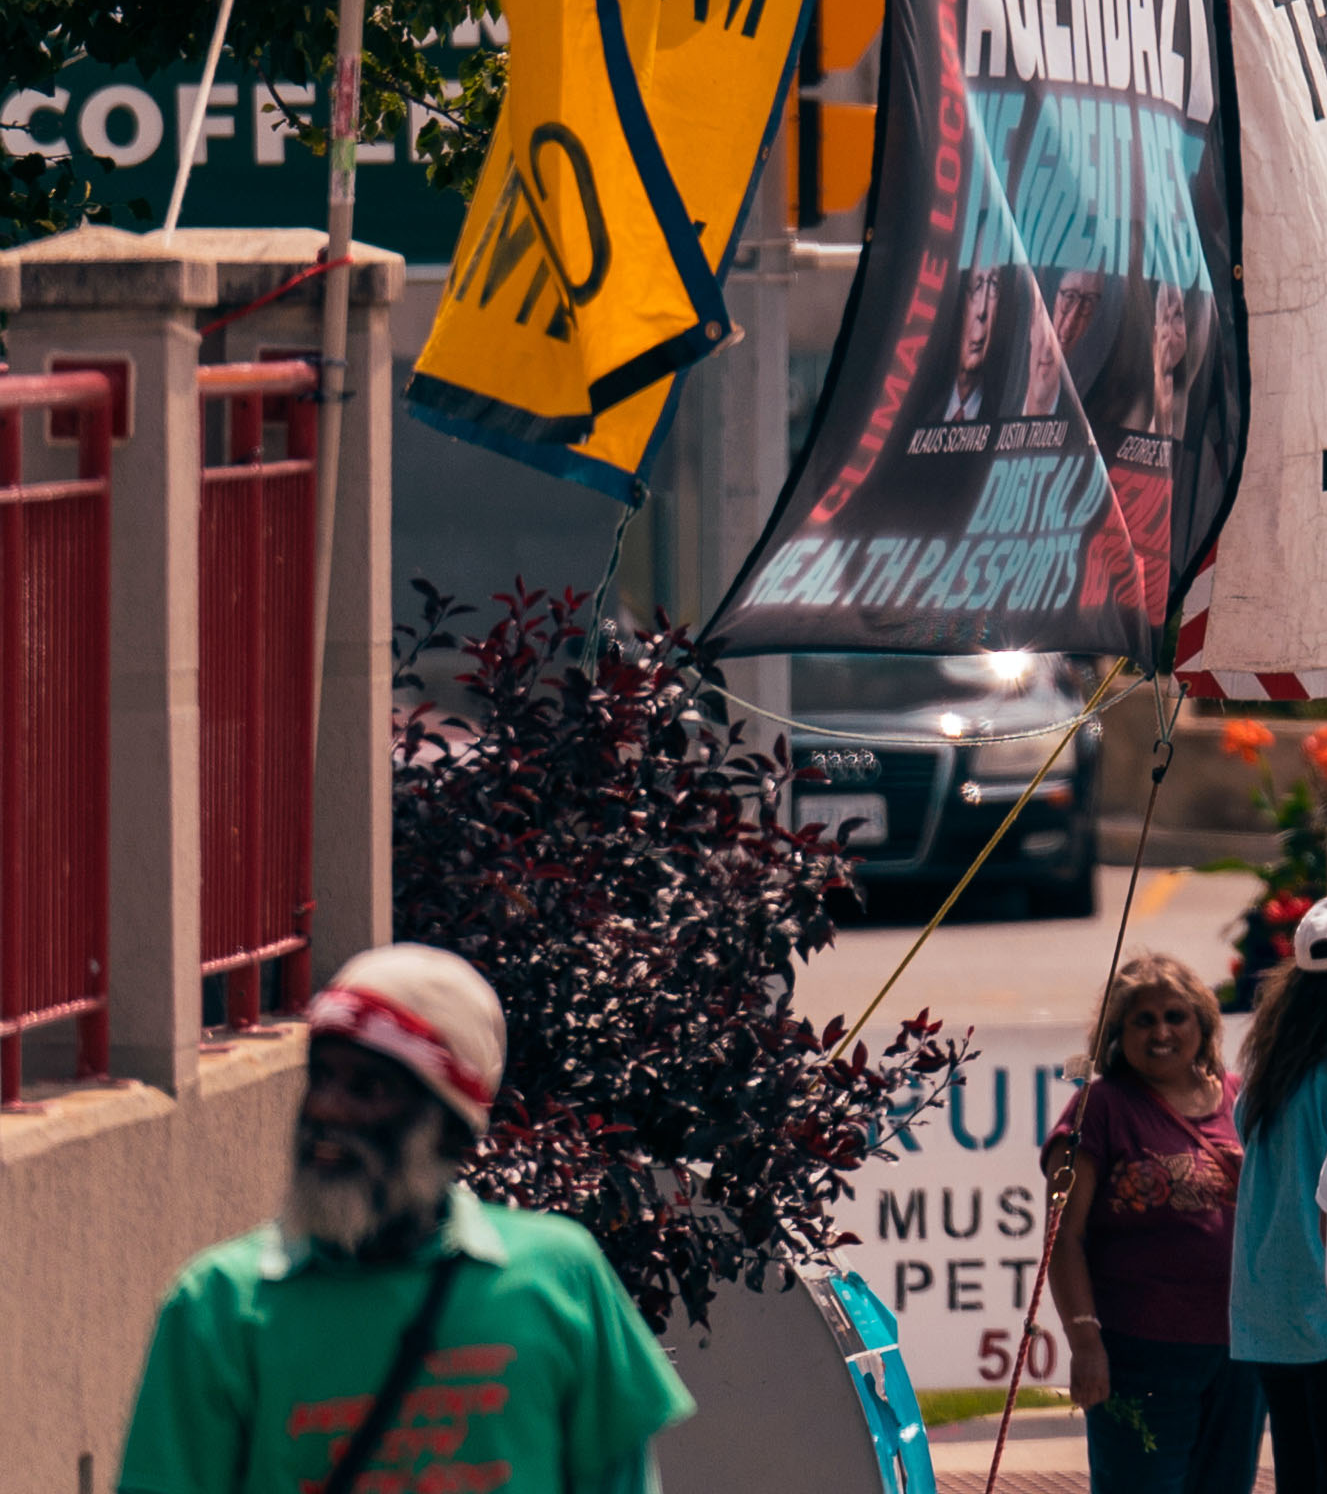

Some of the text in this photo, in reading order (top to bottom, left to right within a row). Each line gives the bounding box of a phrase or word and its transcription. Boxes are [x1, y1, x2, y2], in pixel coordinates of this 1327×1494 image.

[1014, 92, 1140, 278] GREAT
[809, 247, 954, 524] CLIMATE
[906, 427, 948, 455] KLAUS
[943, 423, 991, 453] SCHWAB
[994, 422, 1030, 451] JUSTIN
[1025, 420, 1069, 448] TRUDEAU
[1116, 435, 1162, 464] GEORGE
[966, 455, 1085, 534] DIGITAL
[738, 537, 921, 611] HEALTH
[893, 531, 1081, 612] PASSPORTS
